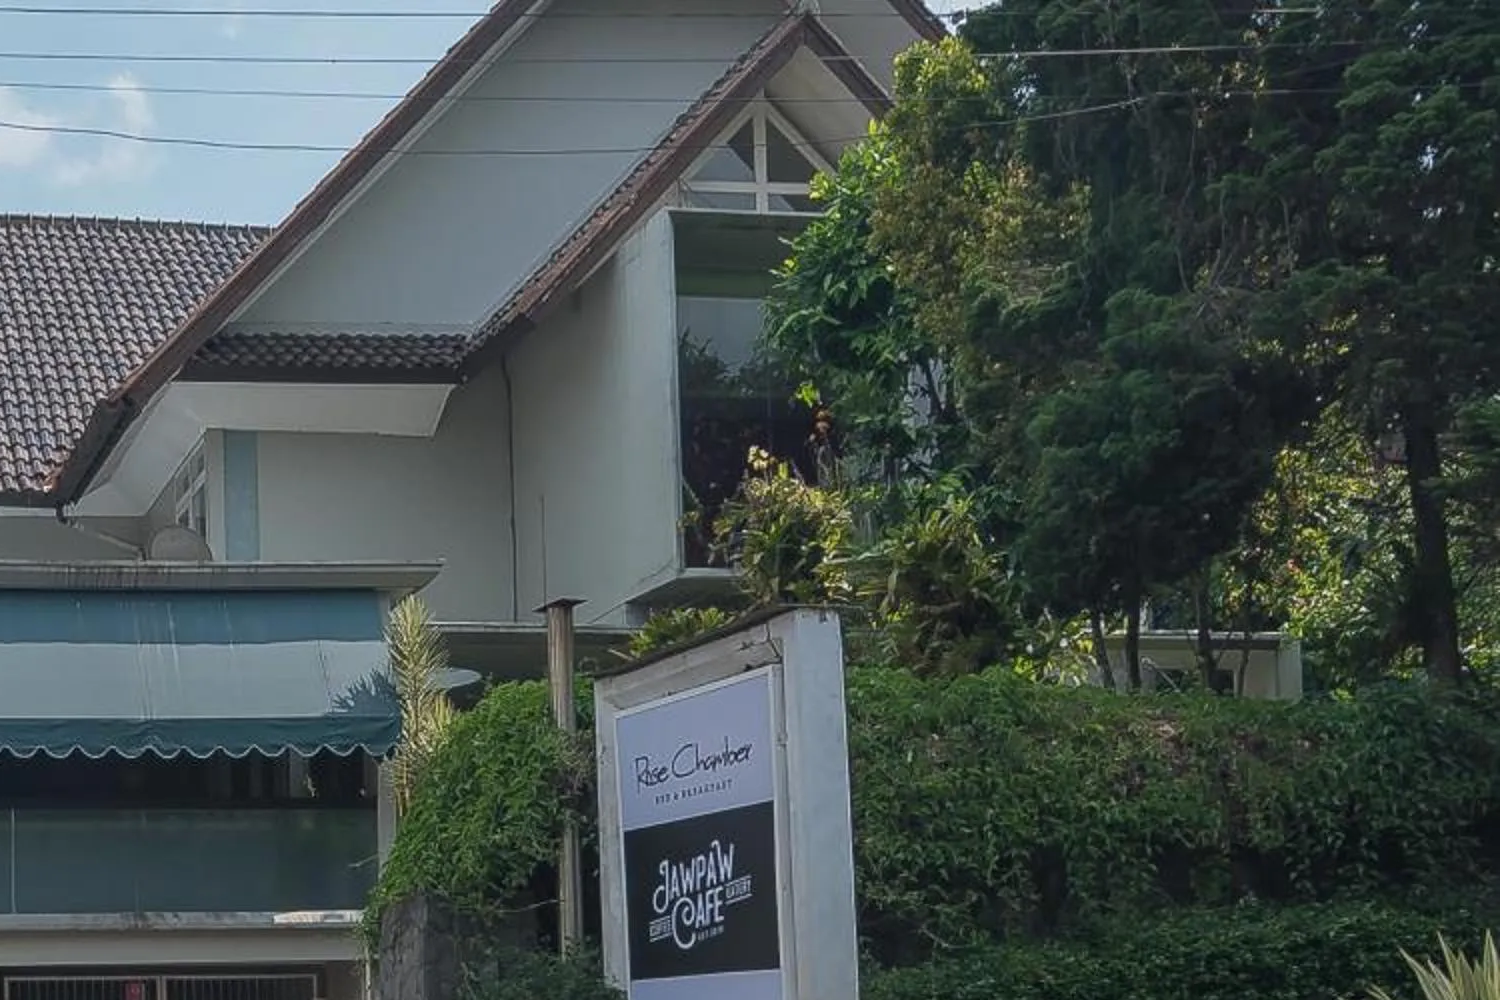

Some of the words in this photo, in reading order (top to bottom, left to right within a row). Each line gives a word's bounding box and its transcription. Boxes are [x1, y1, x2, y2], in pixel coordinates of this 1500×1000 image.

[672, 736, 752, 778] Chamber
[653, 839, 735, 913] JAWPAW
[672, 886, 725, 949] CAFE
